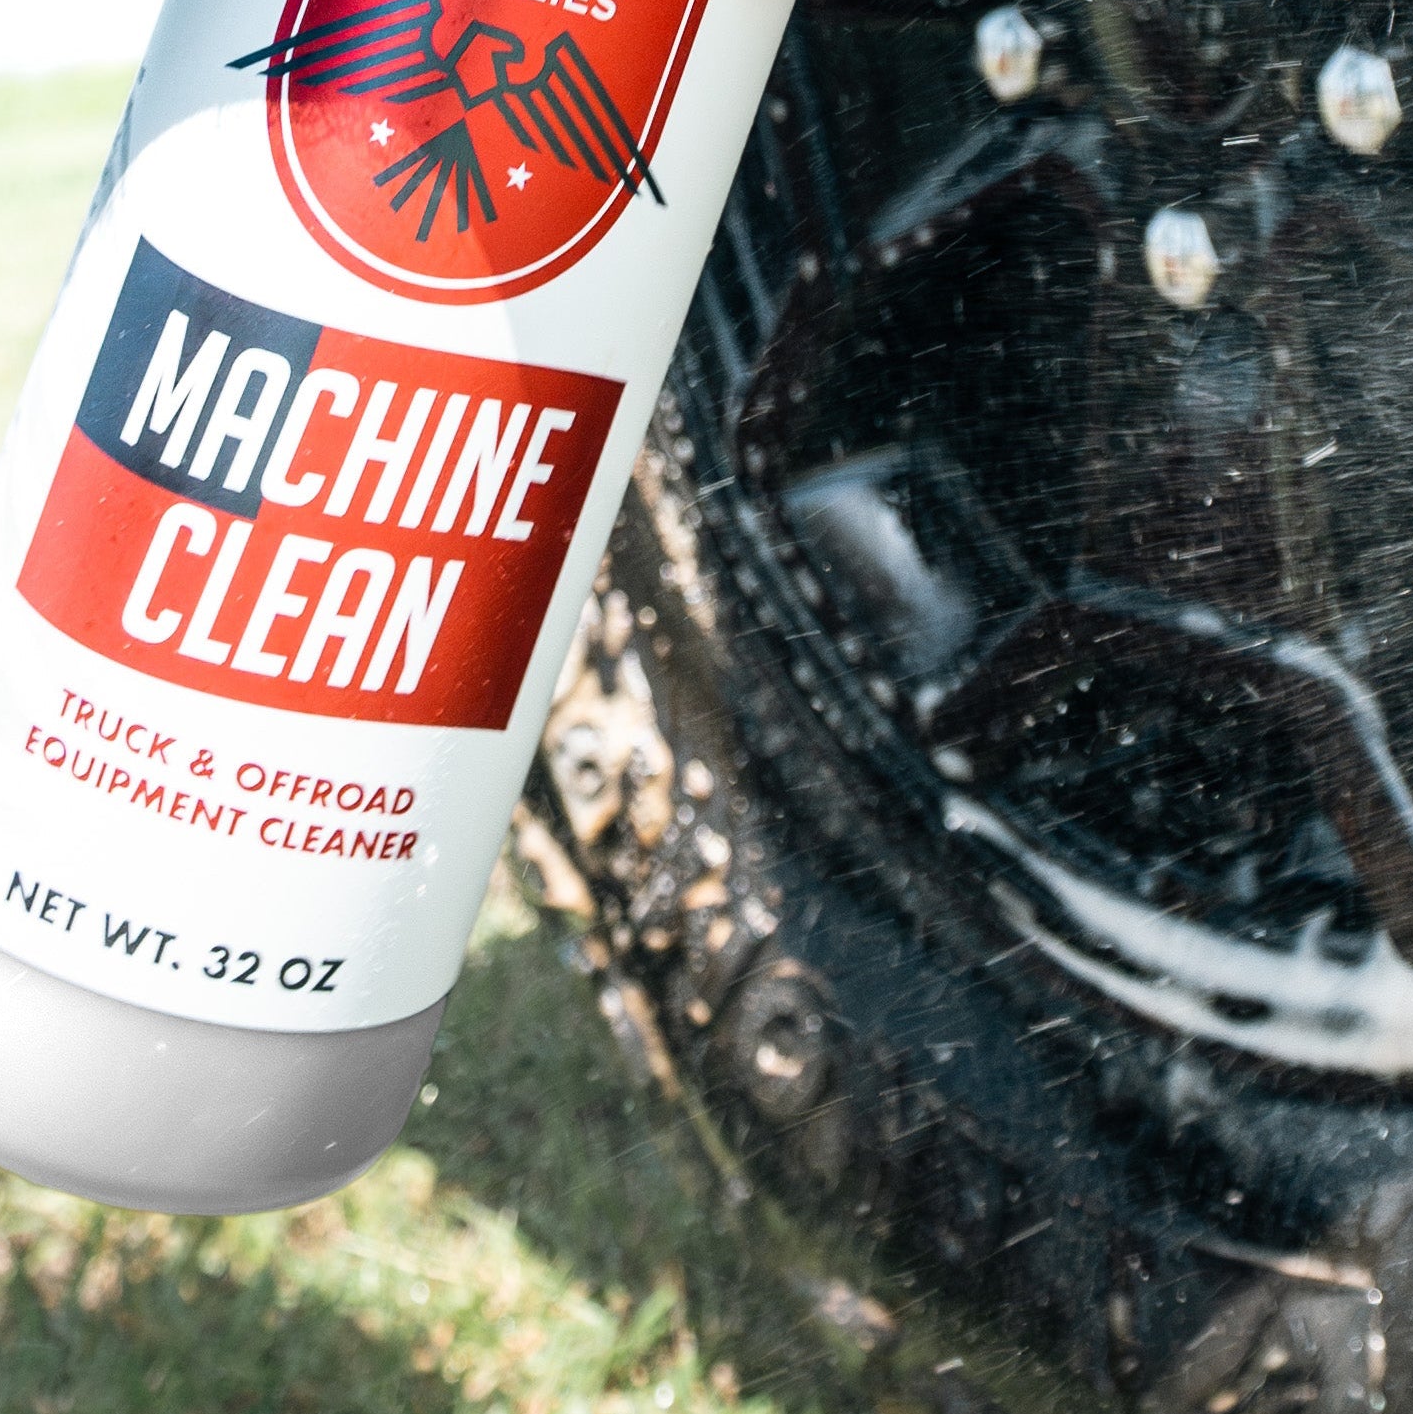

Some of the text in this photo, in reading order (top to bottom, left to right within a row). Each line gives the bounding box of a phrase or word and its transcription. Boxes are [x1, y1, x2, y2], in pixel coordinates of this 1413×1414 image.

[119, 308, 577, 541] MACHINE
[120, 502, 466, 695] CLEAN
[25, 725, 417, 860] EQUIPMENT CLEANER
[61, 689, 414, 816] TRUCK & OFFROAD
[6, 872, 344, 992] NET WT. 32 OZ
